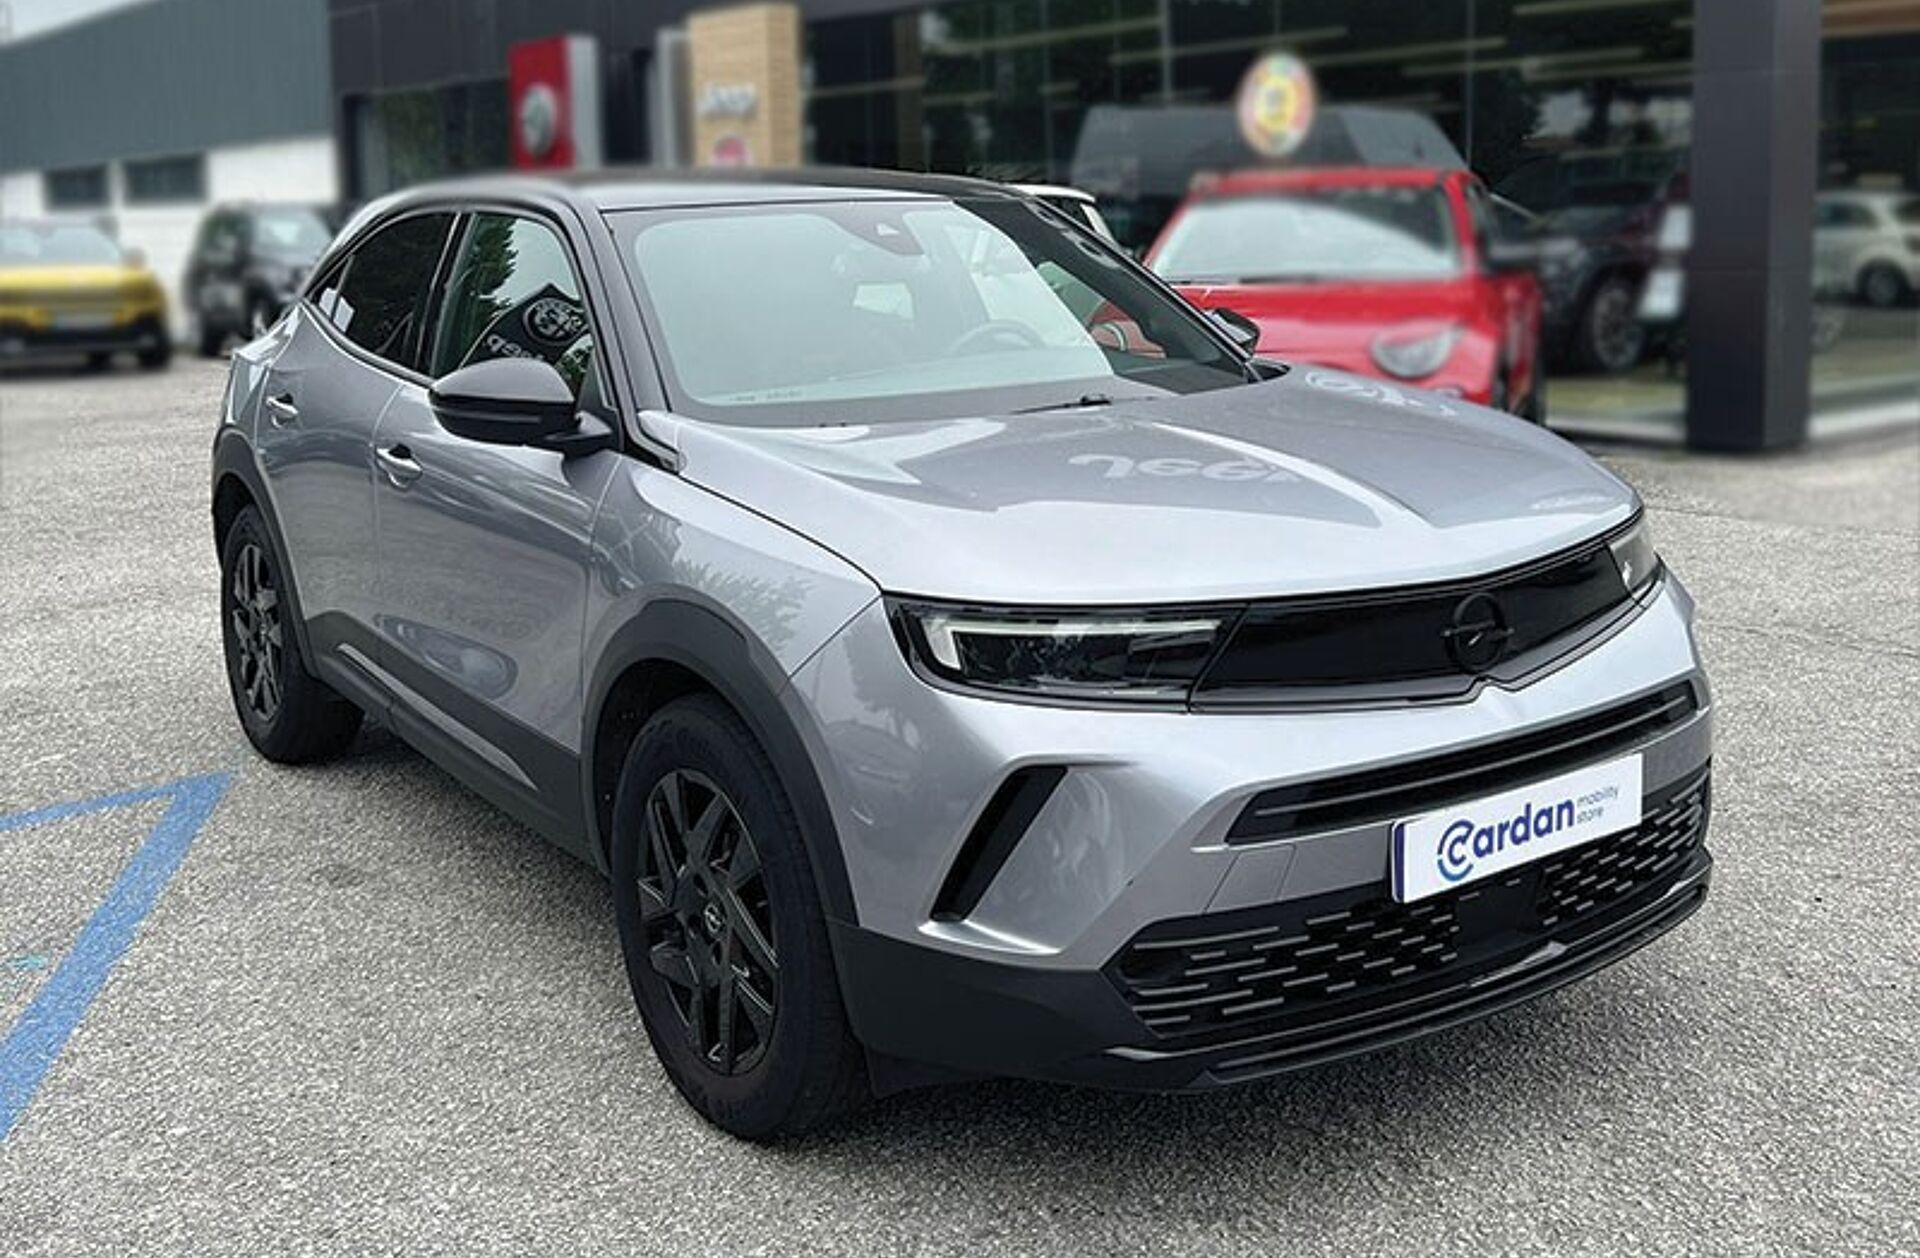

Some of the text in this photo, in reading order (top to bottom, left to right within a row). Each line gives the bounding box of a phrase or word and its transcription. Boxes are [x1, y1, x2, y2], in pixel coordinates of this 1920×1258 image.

[1577, 785, 1619, 808] mobility
[1577, 806, 1604, 824] store
[1437, 799, 1576, 882] Cardan
